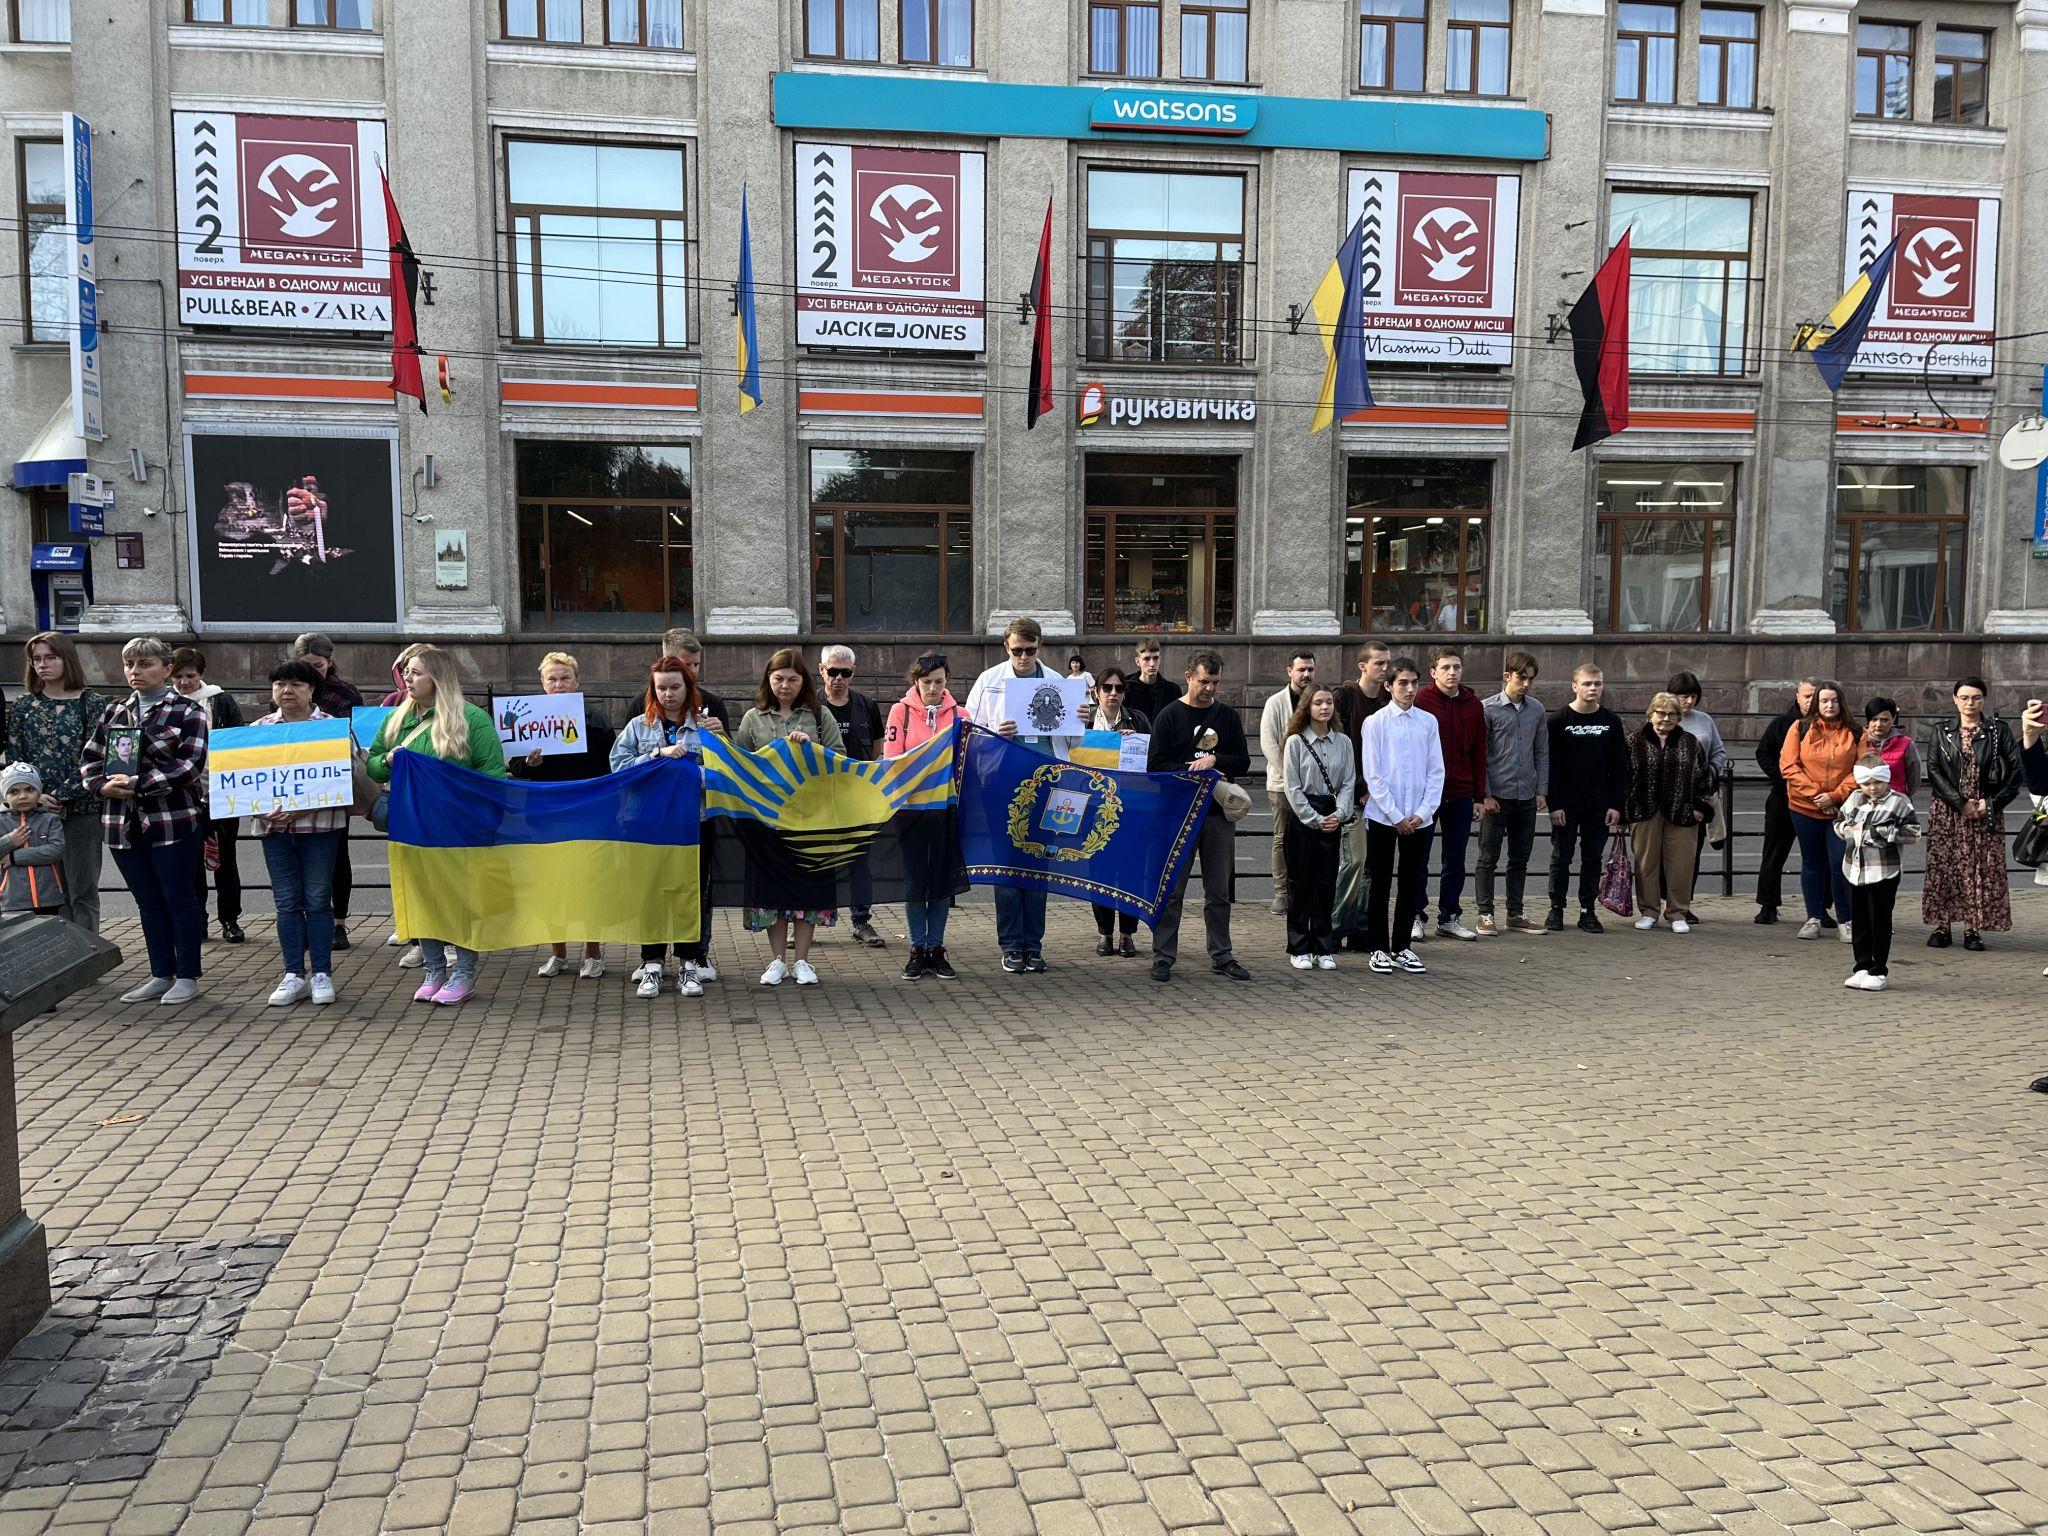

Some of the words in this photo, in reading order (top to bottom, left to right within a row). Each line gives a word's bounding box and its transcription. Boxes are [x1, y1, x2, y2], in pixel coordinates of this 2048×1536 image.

[1113, 98, 1237, 123] watsons
[195, 214, 223, 254] 2
[193, 255, 225, 264] поверх
[812, 240, 838, 279] 2
[190, 275, 212, 286] УСІ
[216, 276, 265, 289] БРЕНДИ
[268, 278, 277, 288] В
[280, 278, 339, 292] ОДНОМУ
[342, 281, 381, 293] МІСЦІ
[810, 280, 838, 288] поверх
[1363, 262, 1382, 298] 2
[186, 297, 297, 317] PULL&BEAR
[314, 301, 388, 322] ZARA
[807, 299, 827, 309] УСІ
[830, 300, 873, 312] БРЕНДИ
[876, 302, 883, 310] В
[886, 302, 939, 314] ОДНОМУ
[941, 304, 975, 316] МІСЦІ
[815, 320, 873, 337] JACK
[896, 323, 967, 341] JONES
[1363, 316, 1371, 326] СІ
[1374, 317, 1413, 329] БРЕНДИ
[1415, 319, 1421, 328] В
[1424, 318, 1471, 330] ОДНОМУ
[1473, 320, 1505, 331] МІСЦІ
[1364, 335, 1441, 354] Massimo
[1447, 336, 1493, 357] Dutti
[1868, 331, 1903, 341] БРЕНДИ
[1906, 332, 1912, 340] В
[1914, 331, 1957, 343] ОДНОМУ
[1927, 350, 1987, 367] Bershka
[1110, 398, 1256, 426] рукавичка
[272, 783, 305, 799] ЦЕ
